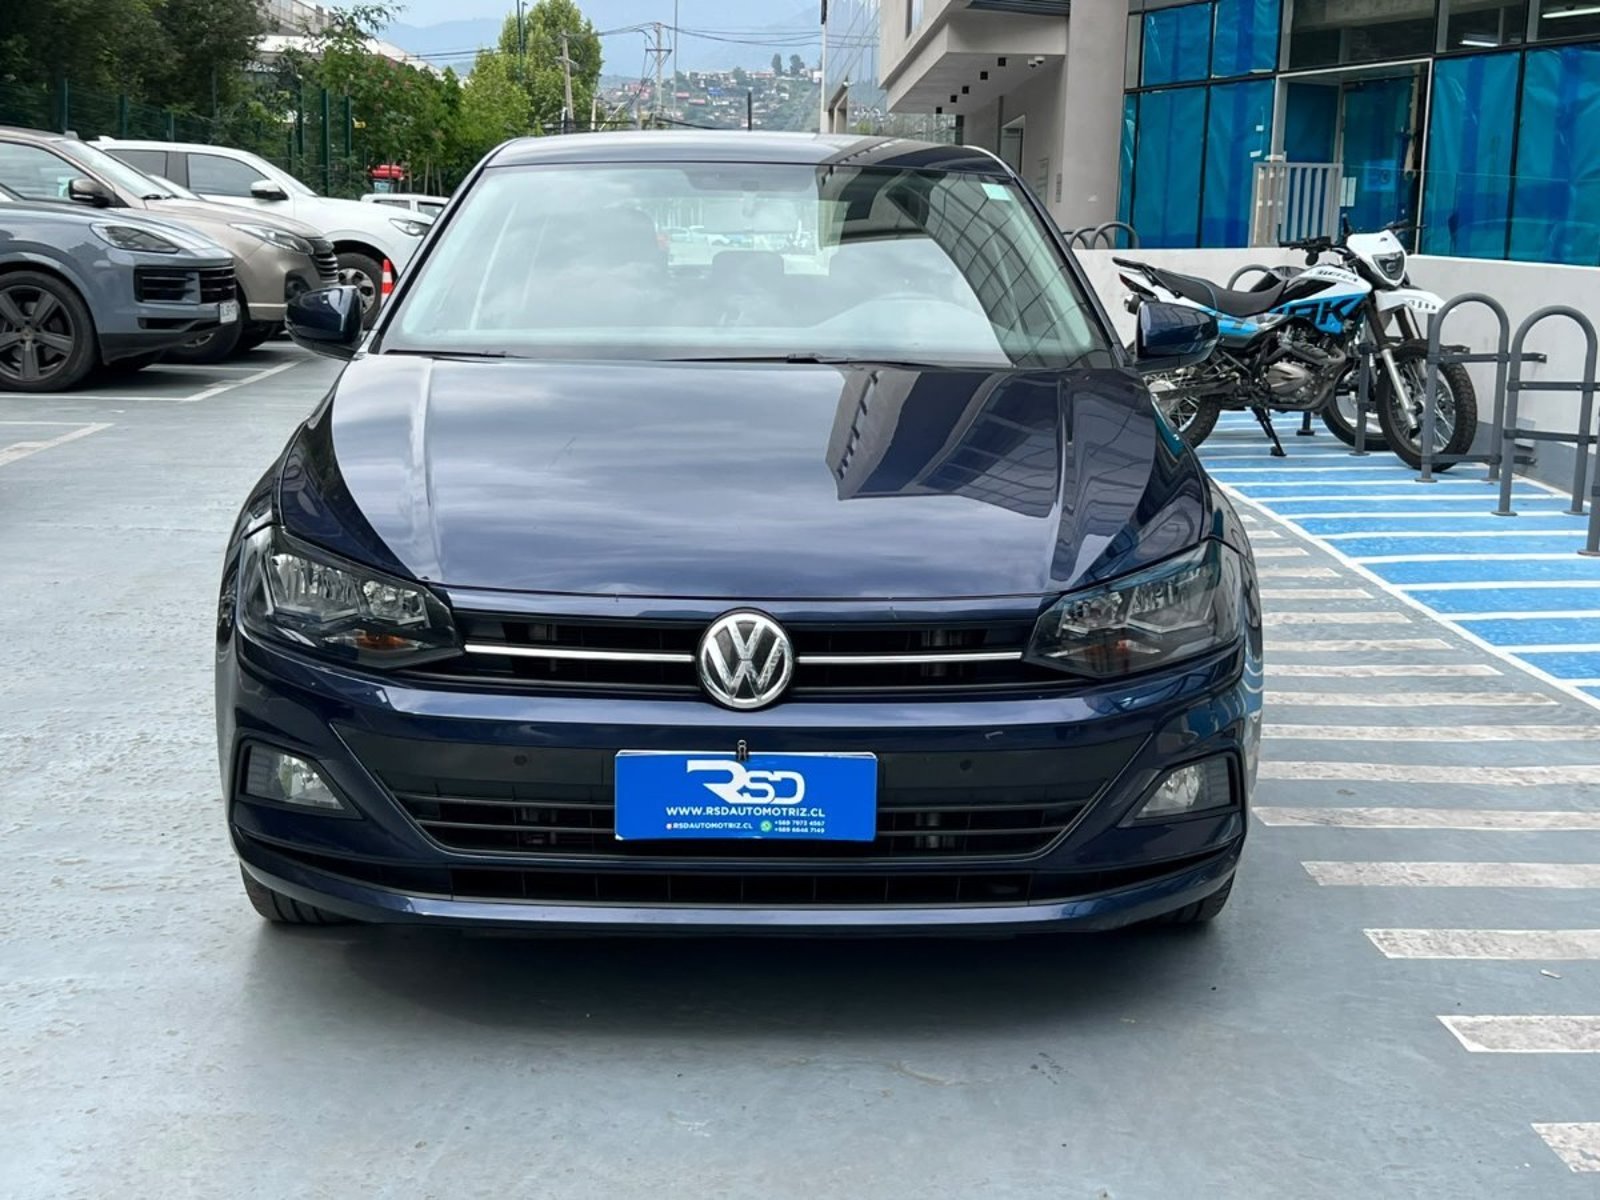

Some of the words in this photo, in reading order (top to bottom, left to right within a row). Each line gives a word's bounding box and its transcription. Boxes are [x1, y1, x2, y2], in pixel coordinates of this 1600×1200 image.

[686, 759, 805, 805] RSD
[665, 806, 826, 818] WWW.RSDAUTOMOTRIZ.CL
[672, 822, 753, 830] RSDAUTOMOTRIZ.CL
